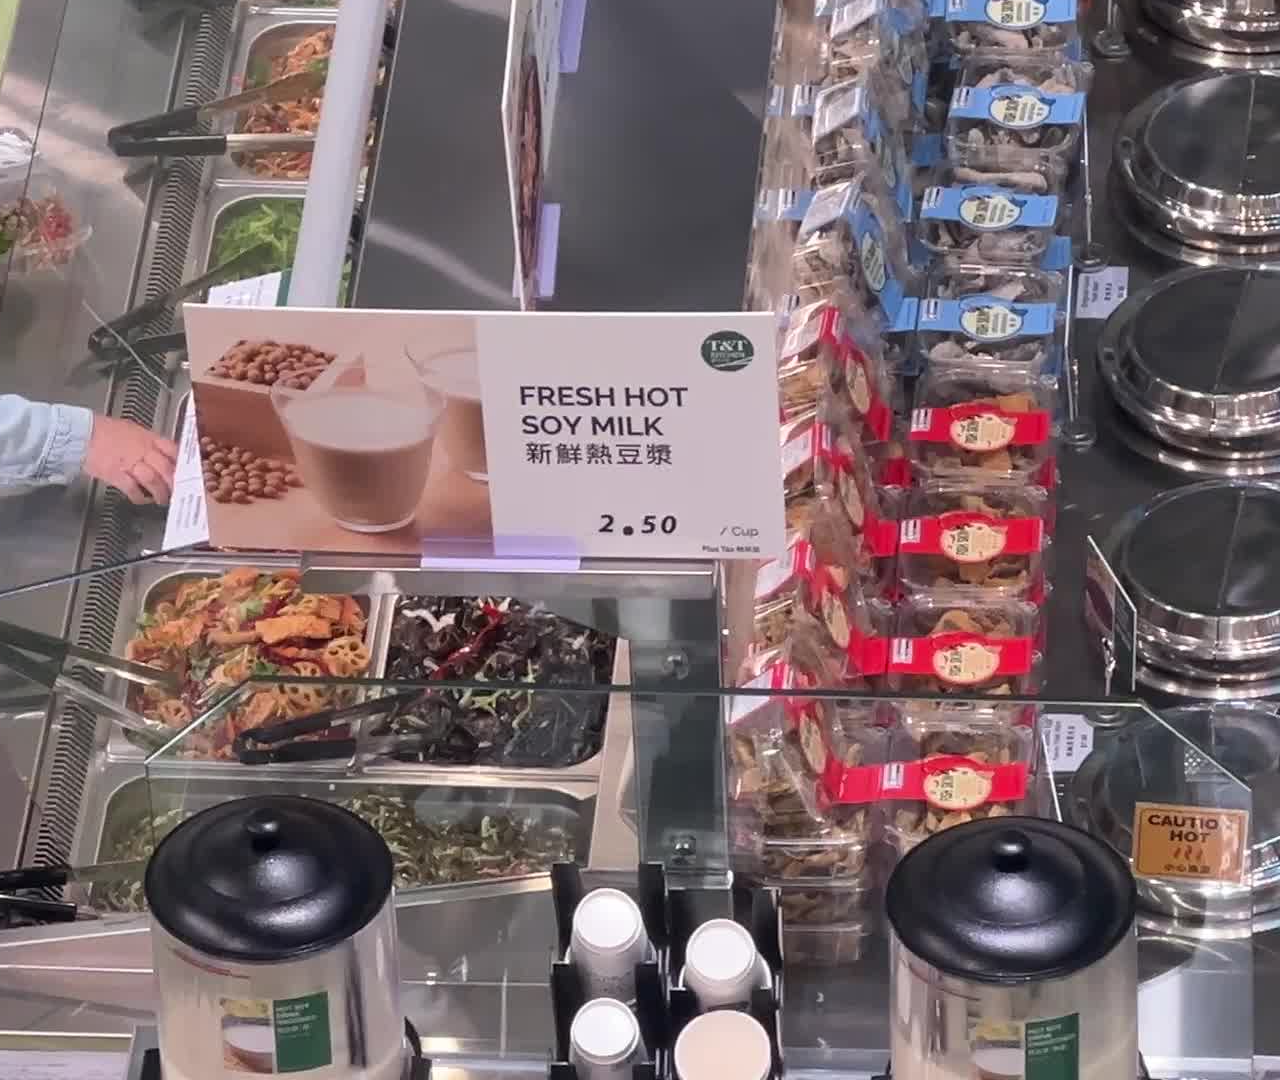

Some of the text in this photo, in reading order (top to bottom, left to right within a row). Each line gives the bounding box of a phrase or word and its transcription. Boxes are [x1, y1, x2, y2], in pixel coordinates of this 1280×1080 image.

[706, 339, 748, 351] T&T
[520, 386, 688, 407] FRESH HOT
[521, 415, 664, 436] SOY MILK
[525, 443, 672, 465] 新鮮熱豆漿
[598, 514, 677, 536] 2.50
[731, 526, 759, 537] Cup
[1147, 814, 1225, 831] CAUTIO
[1170, 830, 1210, 844] HOT
